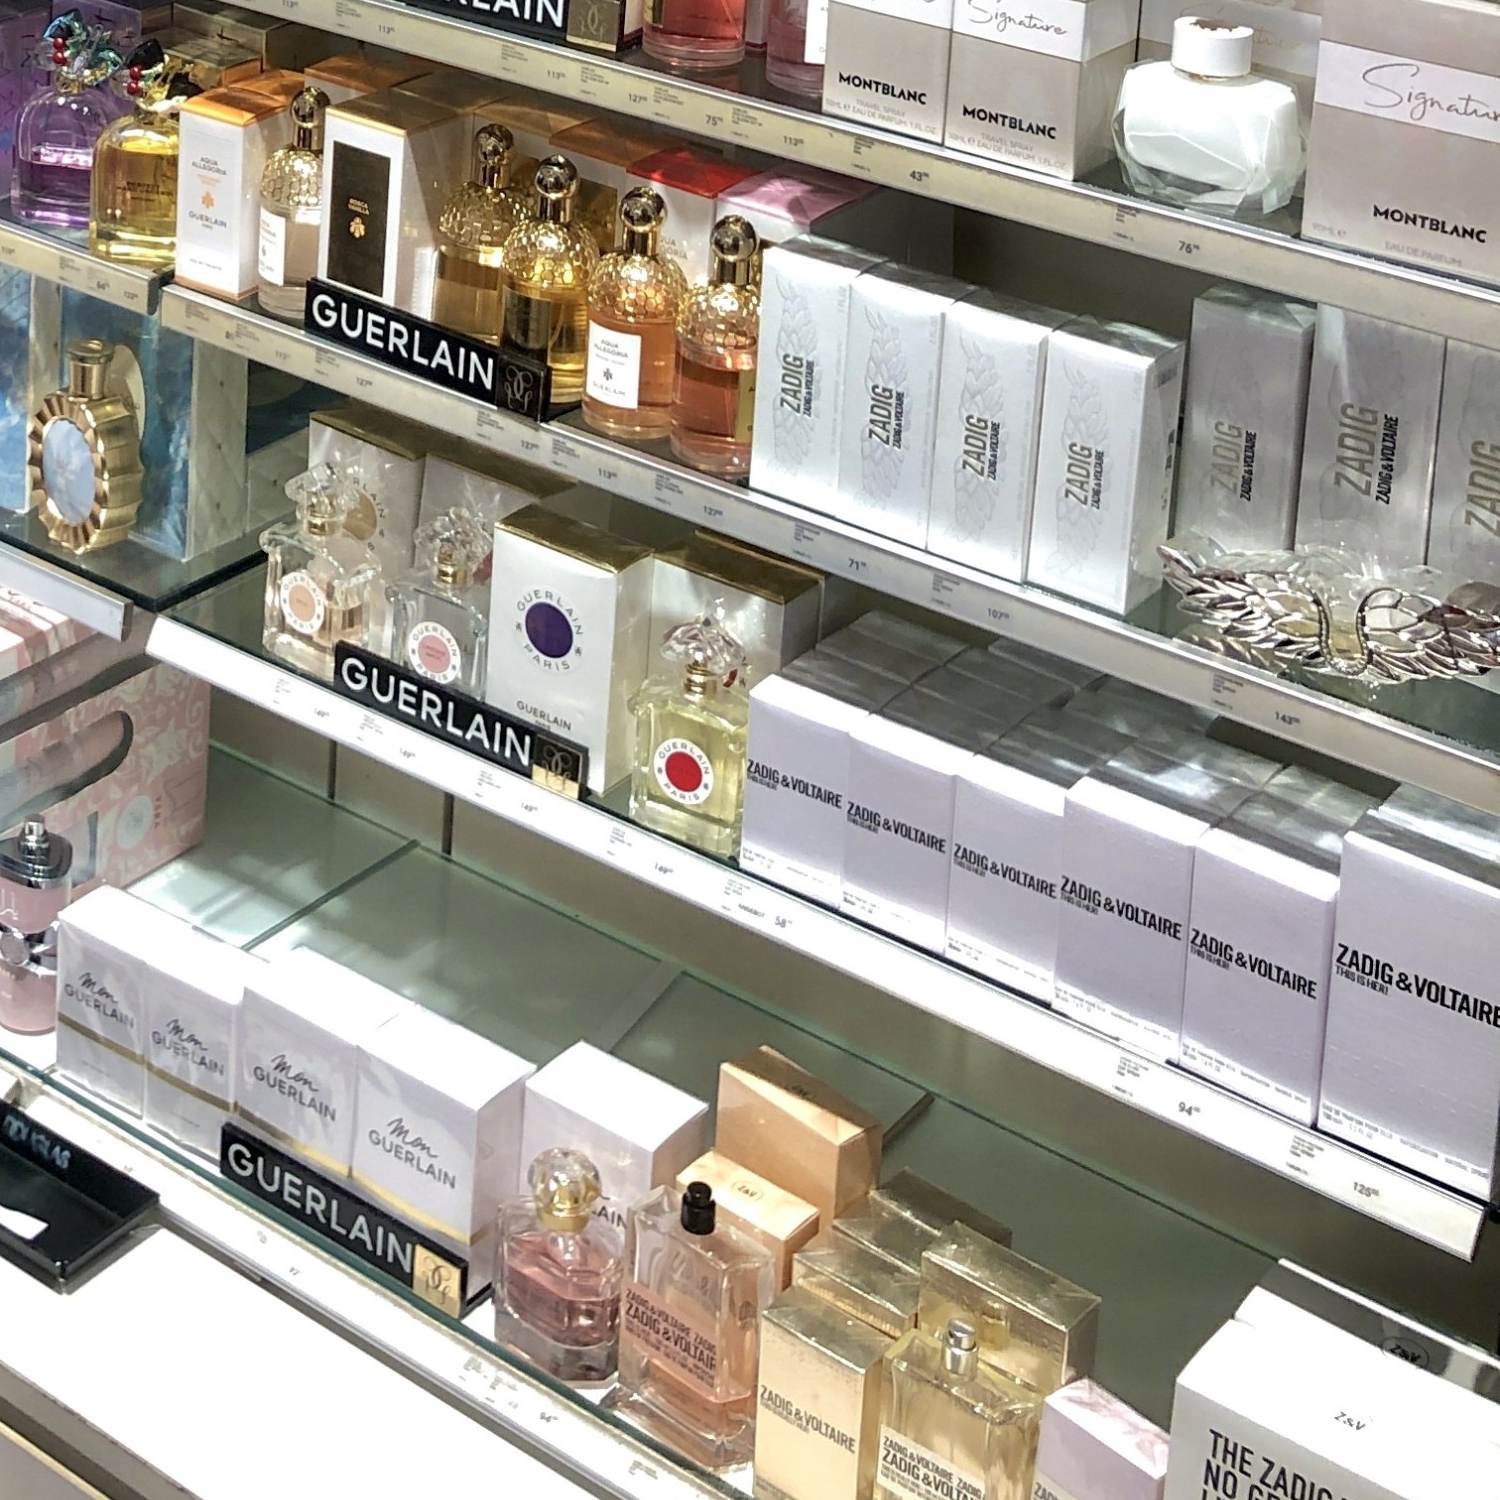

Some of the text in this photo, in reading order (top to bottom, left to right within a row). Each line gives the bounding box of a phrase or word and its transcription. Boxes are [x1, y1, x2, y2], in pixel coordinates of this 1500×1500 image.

[838, 71, 927, 105] MONTBLANC
[1362, 63, 1500, 122] Signatur
[963, 104, 1057, 139] MONTBLANC
[189, 210, 227, 229] GUERLAIN
[1373, 204, 1486, 243] MONTBLANC
[313, 294, 493, 391] GUERLAIN
[599, 337, 619, 350] AQUA
[779, 354, 803, 413] ZADIG
[868, 385, 894, 447] ZADIG
[961, 415, 989, 480] ZADIG
[1064, 441, 1094, 506] ZADIG
[1210, 421, 1243, 494] ZADIG
[1333, 403, 1379, 496] ZADIG
[1465, 439, 1500, 535] ZADIG
[516, 588, 584, 638] GUERLAIN
[522, 645, 572, 673] PARIS
[342, 655, 532, 767] GUERLAIN
[516, 700, 572, 731] GUERLAIN
[1336, 943, 1393, 985] ZADIG
[64, 984, 135, 1029] GUERLAIN
[152, 1031, 225, 1077] GUERLAIN
[253, 1066, 336, 1121] GUERLAIN
[369, 1131, 456, 1189] GUERLAIN
[227, 1144, 412, 1271] GUERLAIN
[1203, 1459, 1238, 1499] NO
[1209, 1428, 1254, 1478] THE
